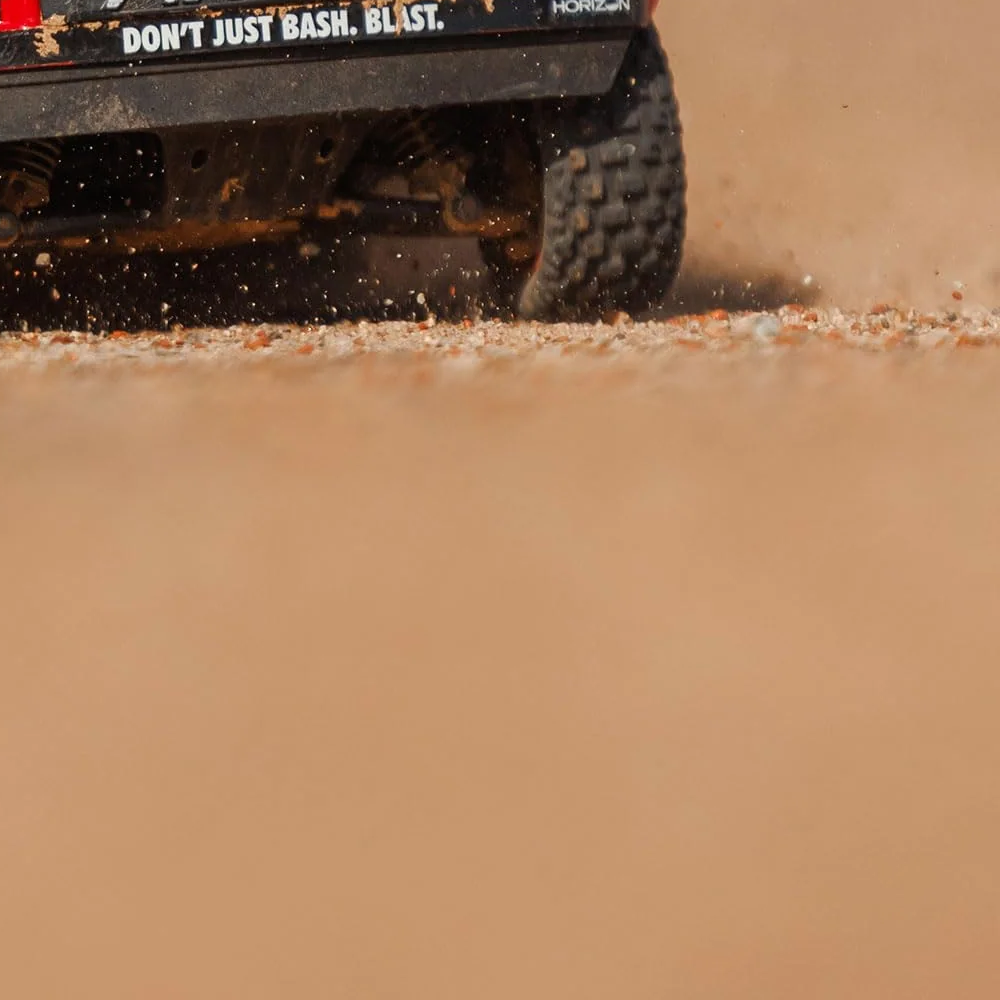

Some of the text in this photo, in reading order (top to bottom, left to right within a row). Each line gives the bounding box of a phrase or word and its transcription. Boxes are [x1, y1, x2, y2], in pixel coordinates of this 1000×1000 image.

[122, 3, 445, 54] DON'T JUST BASH. BLAST.
